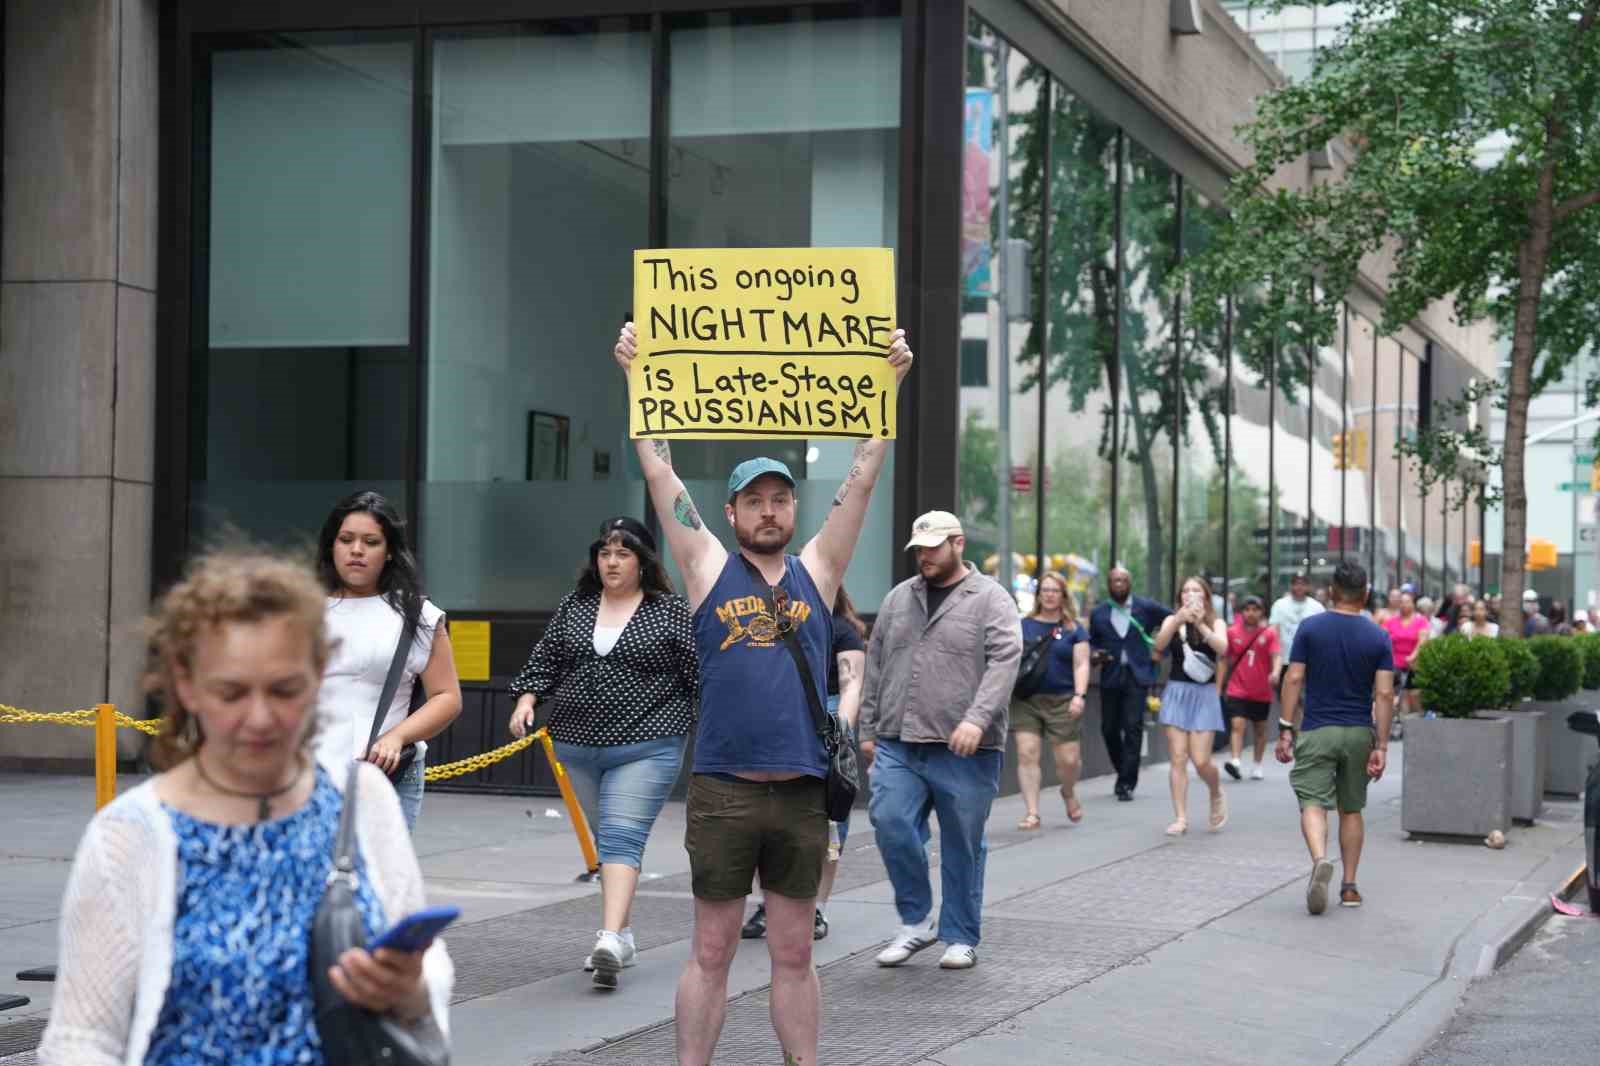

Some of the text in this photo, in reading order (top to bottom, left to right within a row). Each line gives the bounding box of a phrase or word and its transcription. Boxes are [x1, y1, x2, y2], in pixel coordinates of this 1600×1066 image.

[643, 258, 859, 304] This ongoing
[650, 304, 891, 349] NIGHTMARE
[643, 362, 876, 410] is Late-Stage
[638, 391, 888, 437] PRUSSIANISM!
